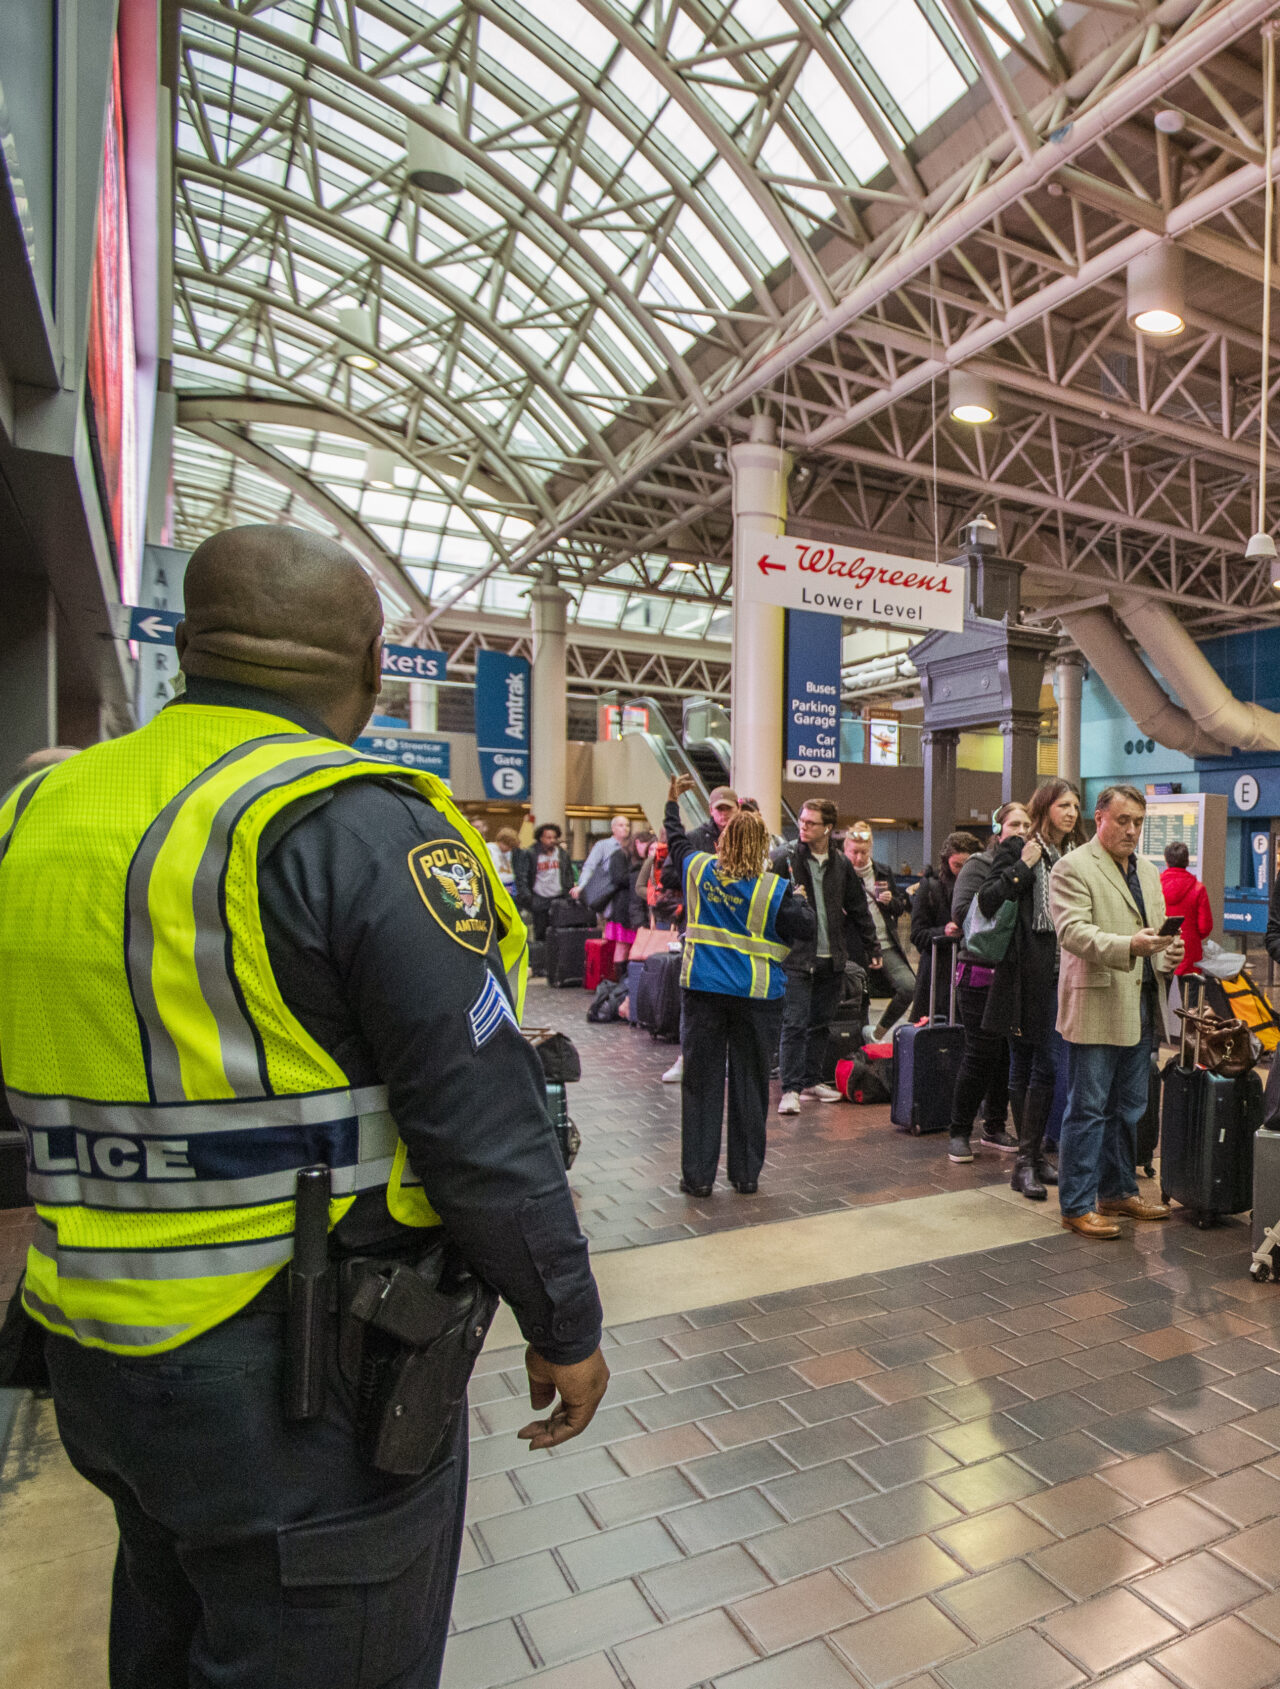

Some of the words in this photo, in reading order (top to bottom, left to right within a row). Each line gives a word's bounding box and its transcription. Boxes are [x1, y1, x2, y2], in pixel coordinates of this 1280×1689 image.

[795, 544, 952, 594] Walgreens
[802, 587, 863, 611] Lower
[872, 598, 923, 620] Level
[383, 648, 439, 676] kets
[806, 681, 836, 695] Buses
[505, 672, 525, 741] Amtrak
[792, 699, 836, 716] Parking
[794, 712, 836, 729] Garage
[400, 741, 441, 751] Streetcar
[816, 734, 836, 746] Car
[416, 754, 442, 764] Buses
[493, 754, 524, 766] Gate
[798, 745, 836, 759] Rental
[502, 773, 514, 789] E
[1242, 783, 1250, 802] E
[419, 848, 481, 879] POLICE
[32, 1130, 197, 1178] LICE
